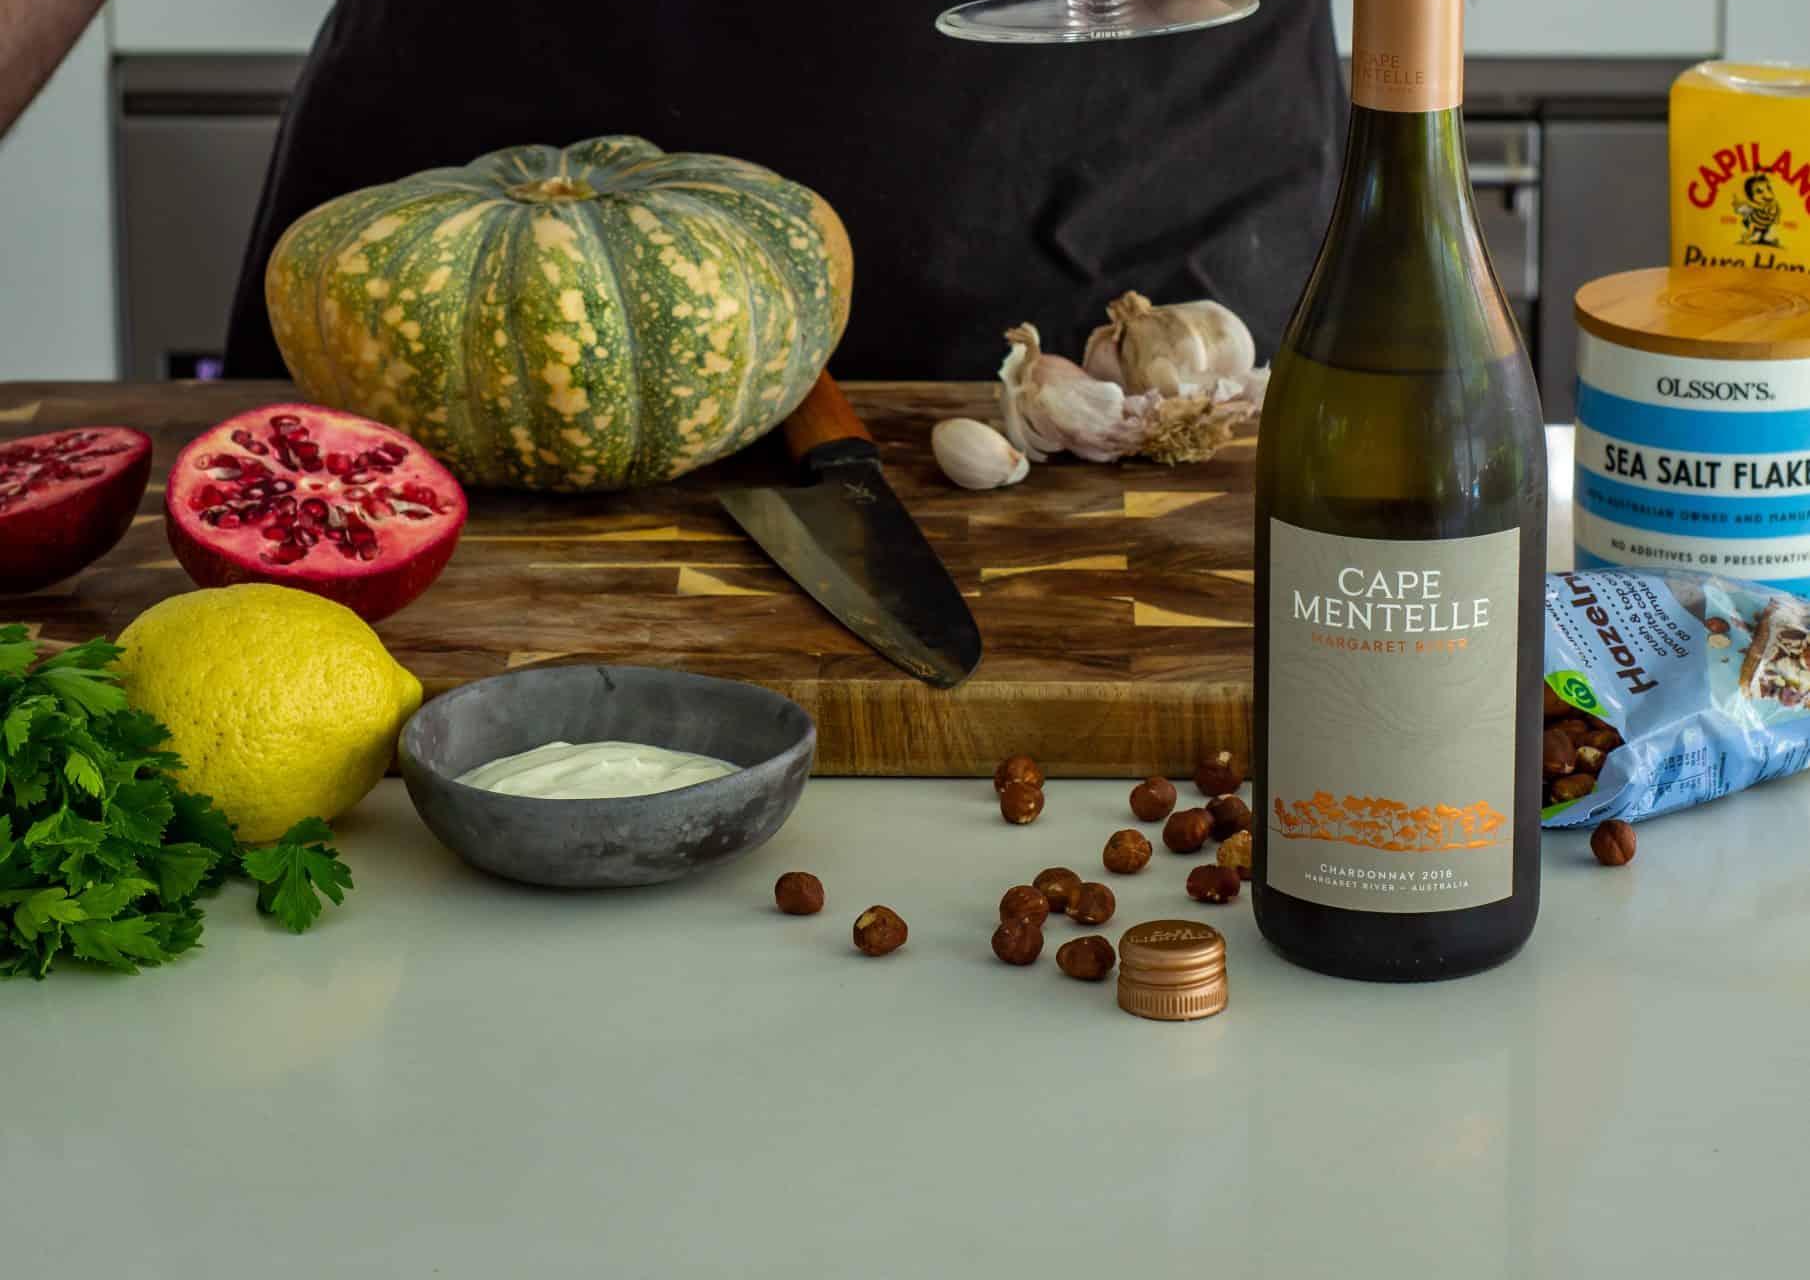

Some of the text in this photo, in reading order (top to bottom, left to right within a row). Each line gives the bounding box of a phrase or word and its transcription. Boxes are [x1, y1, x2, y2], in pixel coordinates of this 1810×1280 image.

[1604, 443, 1648, 482] SEA
[1656, 455, 1721, 489] SALT
[1734, 513, 1763, 524] AND
[1630, 544, 1693, 563] ADDITIVES
[1699, 553, 1718, 565] OR
[1337, 567, 1442, 600] CAPE
[1293, 589, 1490, 633] MENTELLE
[1615, 587, 1634, 611] top
[1637, 580, 1692, 642] as a simple
[1622, 580, 1690, 658] favourite cake
[1629, 612, 1641, 624] &
[1312, 632, 1408, 654] MARGARET
[1638, 624, 1668, 658] crush
[1304, 872, 1359, 889] MARGARET
[1362, 882, 1395, 893] RIVER
[1411, 879, 1470, 892] AUSTRALIA
[1320, 863, 1416, 882] CHARDONNAY
